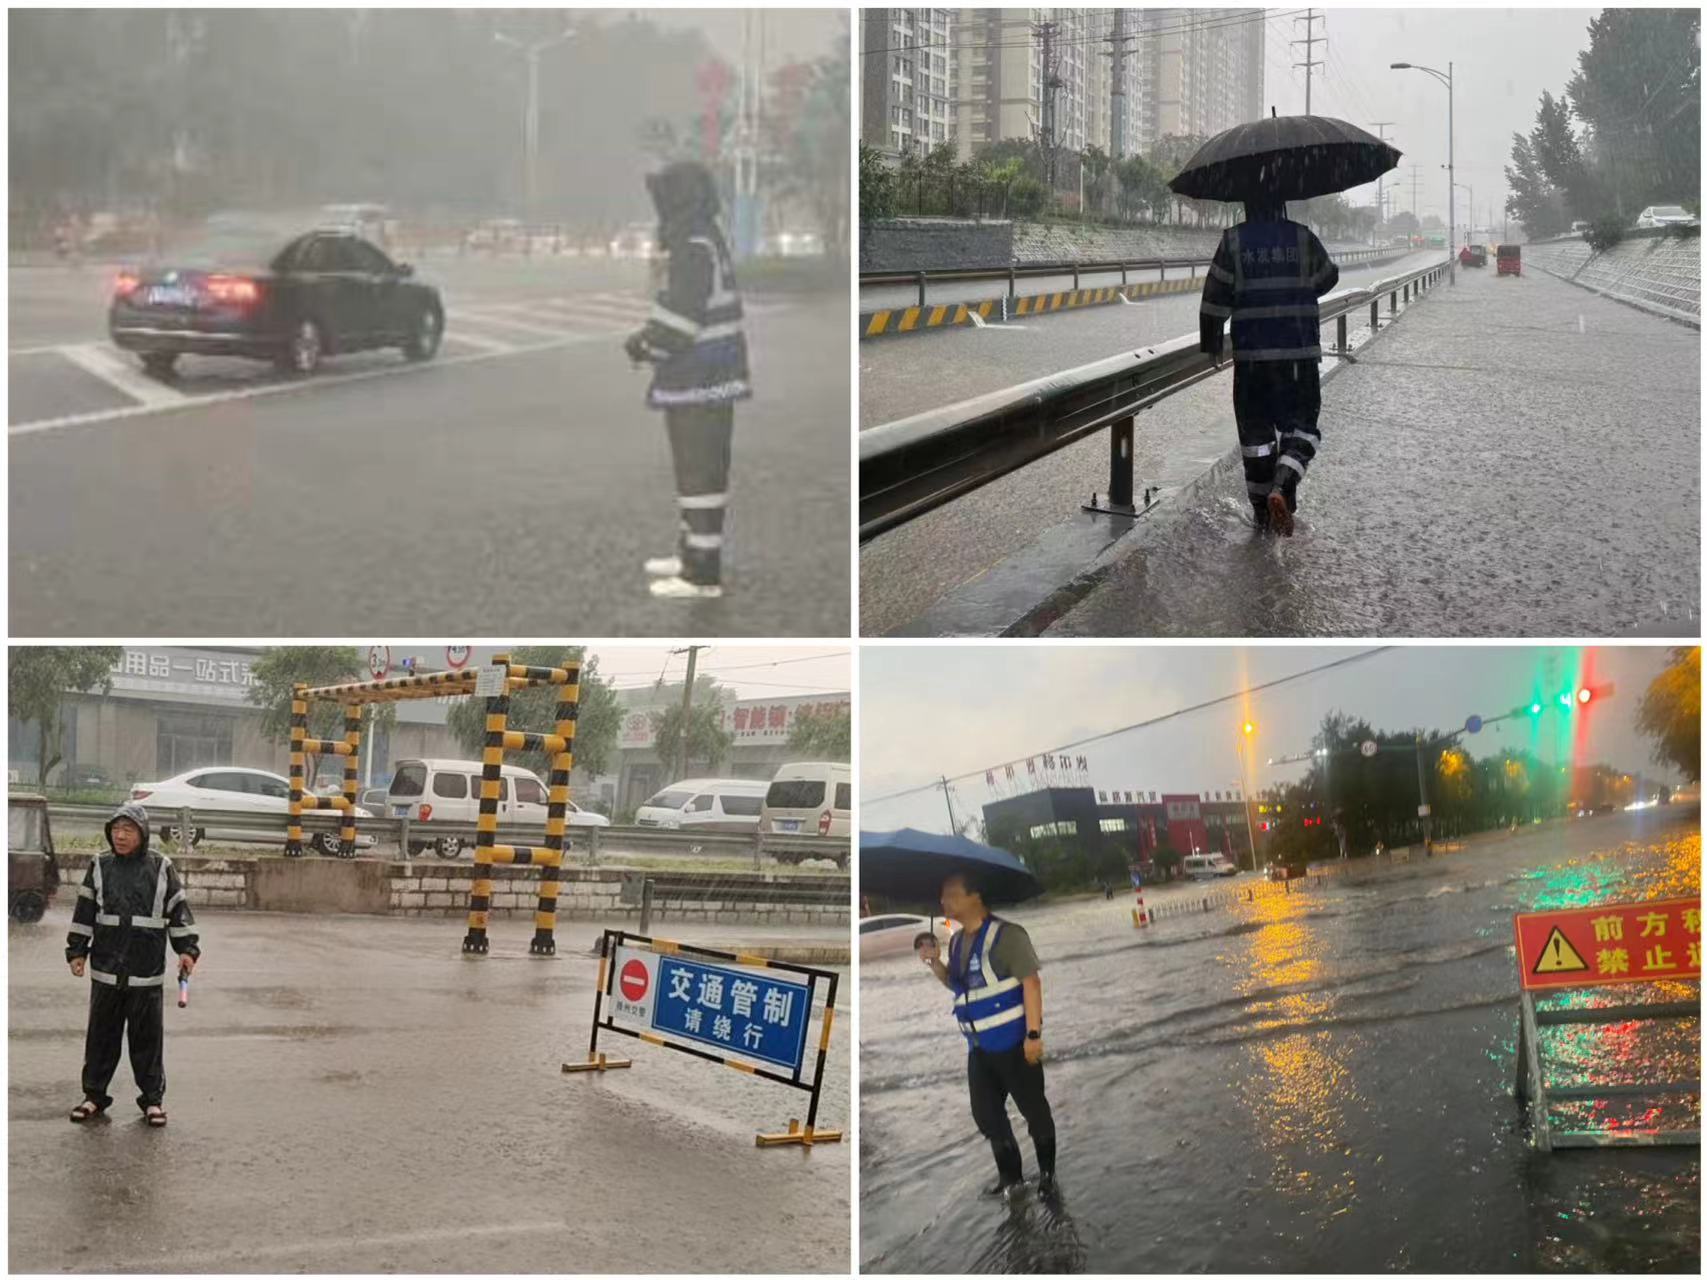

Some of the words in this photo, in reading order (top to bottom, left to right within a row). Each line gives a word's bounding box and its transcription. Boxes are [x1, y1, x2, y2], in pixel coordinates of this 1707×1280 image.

[110, 651, 259, 686] 用品一站式采
[668, 968, 794, 1027] 交通管制
[684, 1007, 764, 1049] 请绕行
